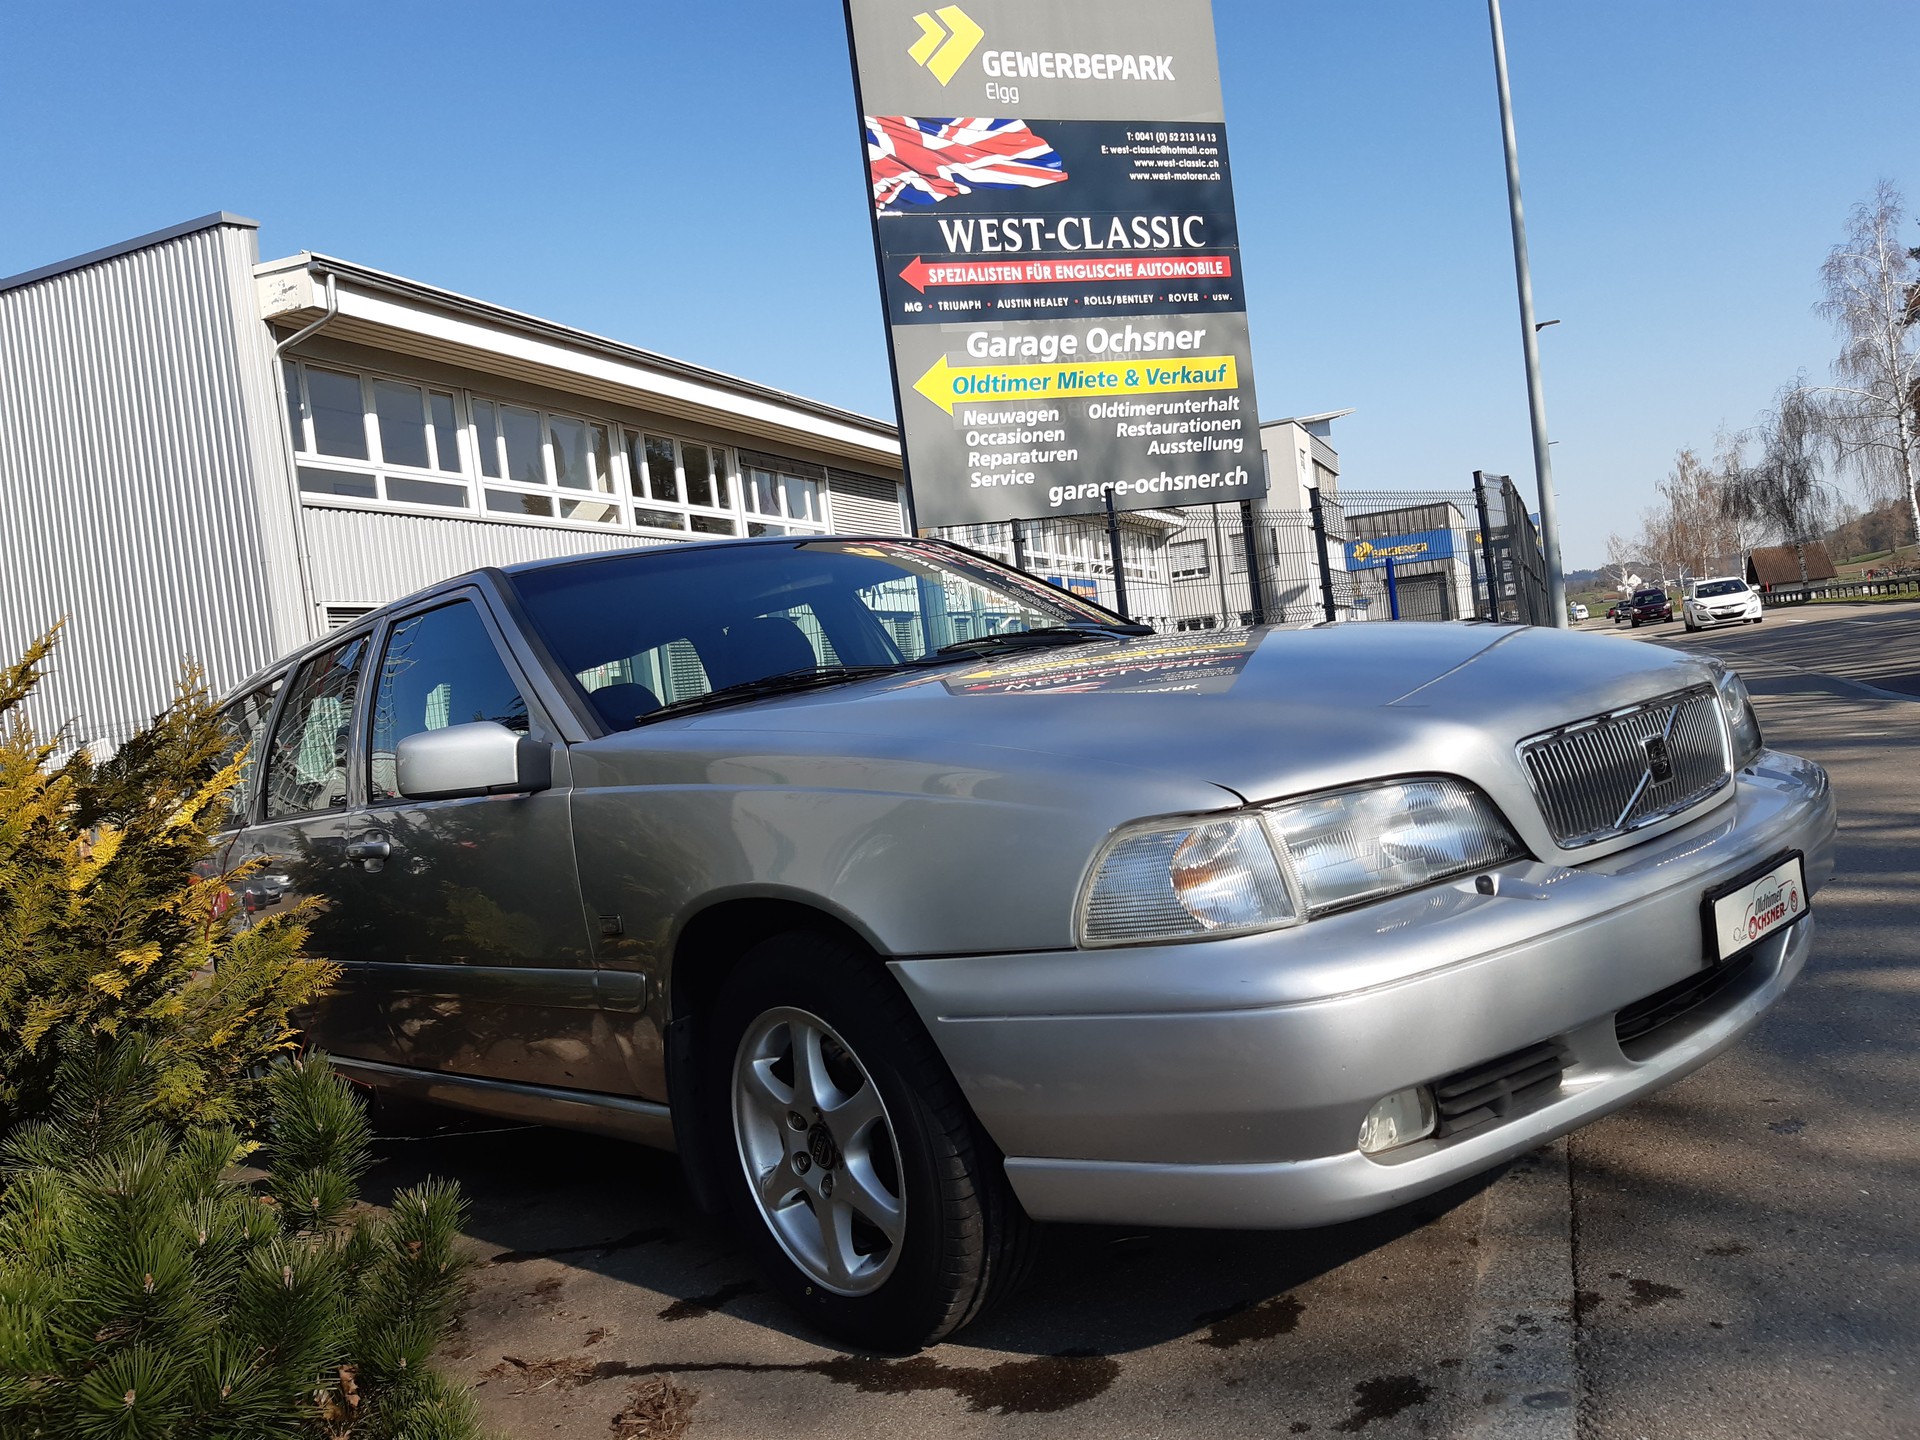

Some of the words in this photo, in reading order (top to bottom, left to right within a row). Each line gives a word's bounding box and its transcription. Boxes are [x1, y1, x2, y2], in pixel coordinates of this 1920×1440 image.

[982, 50, 1175, 81] GEWERBEPARK
[986, 83, 1019, 103] Elgg
[1135, 132, 1154, 141] 0041
[1155, 132, 1168, 143] (0)
[1169, 133, 1179, 142] 52
[1180, 133, 1194, 142] 213
[1197, 133, 1206, 142] 14
[1207, 133, 1217, 142] 13
[1110, 145, 1218, 155] west-classic@hotmail.com
[1134, 159, 1219, 168] www.west-classic.ch
[1129, 171, 1221, 180] www.west-motoren.ch
[938, 216, 1206, 253] WEST-CLASSIC
[928, 266, 1022, 283] SPEZIALISTEN
[1026, 263, 1052, 280] FÜR
[1056, 263, 1133, 280] ENGLISCHE
[1137, 261, 1223, 277] AUTOMOBILE
[904, 302, 923, 312] MG
[938, 300, 982, 311] TRIUMPH
[997, 298, 1032, 309] AUSTIN
[1033, 297, 1069, 308] HEALEY
[1084, 294, 1154, 306] ROLLS/BENTLEY
[1168, 293, 1199, 303] ROVER
[966, 331, 1078, 362] Garage
[1086, 325, 1206, 353] Ochsner
[952, 374, 1051, 395] Oldtimer
[1057, 370, 1118, 390] Miete
[1125, 369, 1140, 386] &
[1146, 364, 1227, 385] Verkauf
[1088, 395, 1240, 419] Oldtimerunterhalt
[963, 409, 1059, 427] Neuwagen
[1116, 418, 1241, 437] Restaurationen
[966, 428, 1065, 447] Occasionen
[1147, 436, 1243, 455] Ausstellung
[968, 449, 1078, 470] Reparaturen
[970, 470, 1035, 488] Service
[1755, 888, 1784, 916] Oldtimer
[1748, 902, 1785, 940] OCHSNER
